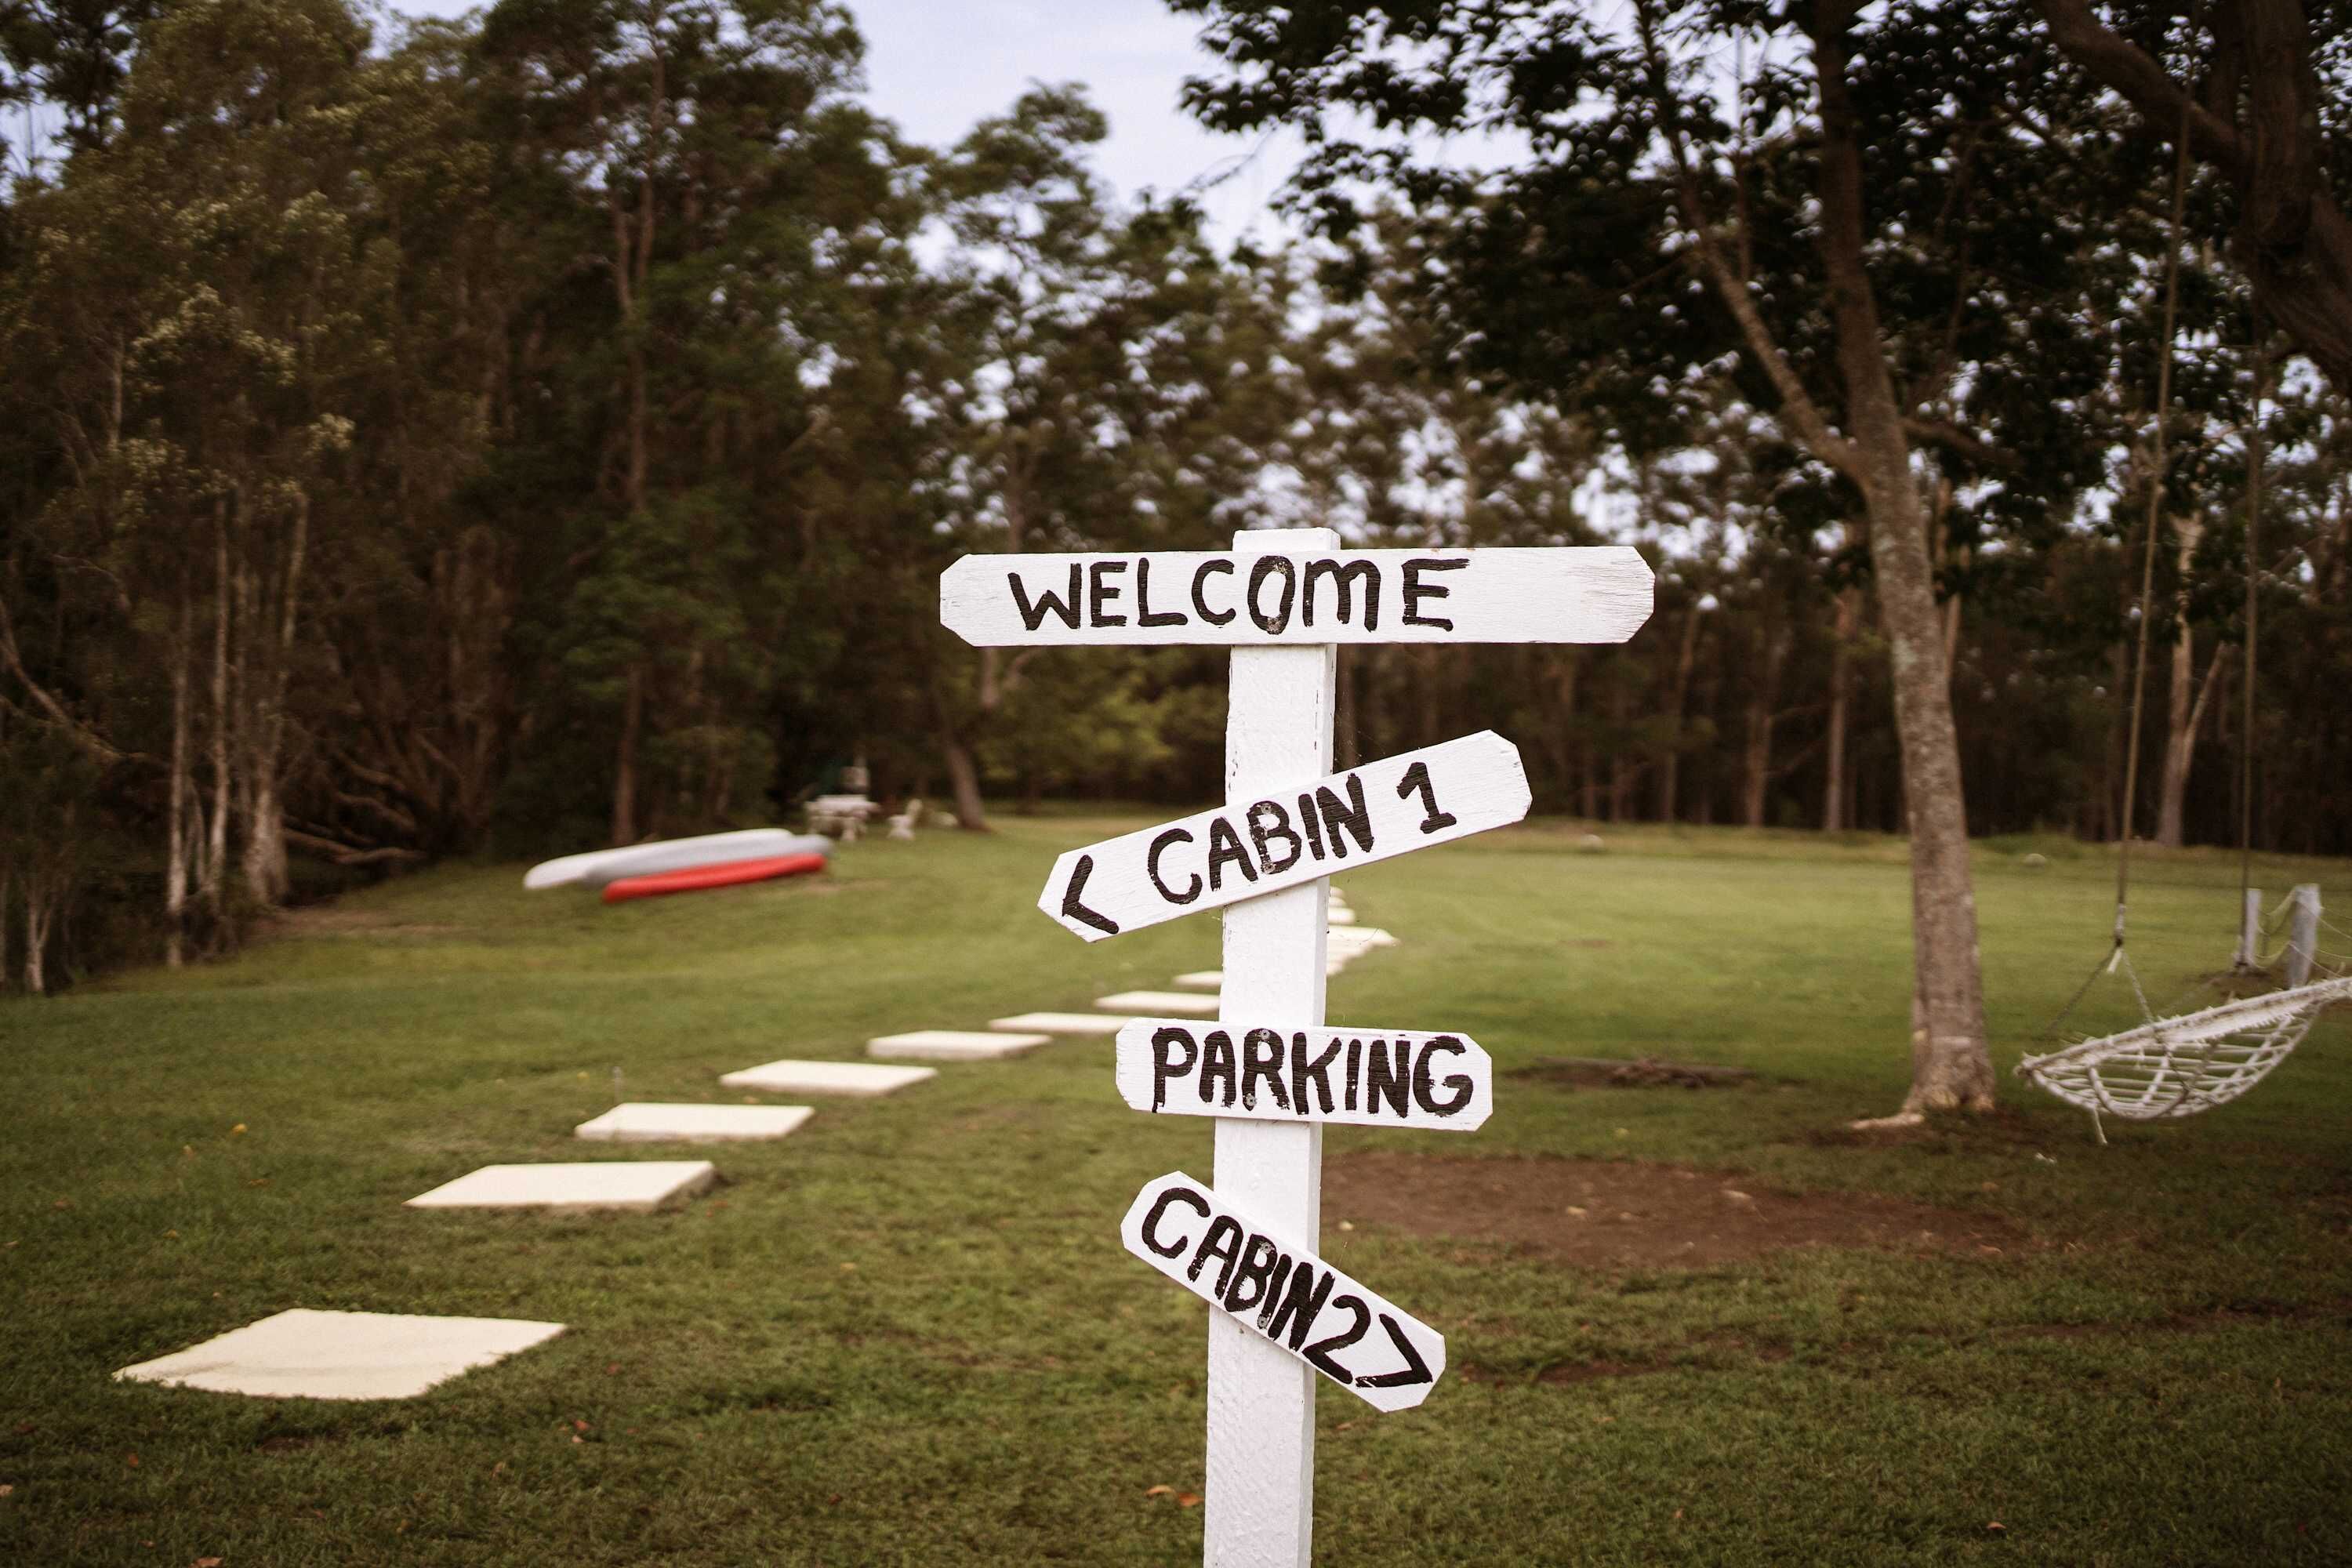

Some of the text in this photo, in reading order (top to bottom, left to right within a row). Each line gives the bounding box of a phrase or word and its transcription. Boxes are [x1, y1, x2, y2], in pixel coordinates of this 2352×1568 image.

[1007, 555, 1470, 635] WELCOME
[1148, 761, 1457, 906] CABIN 1
[1151, 1027, 1474, 1119] PARKING
